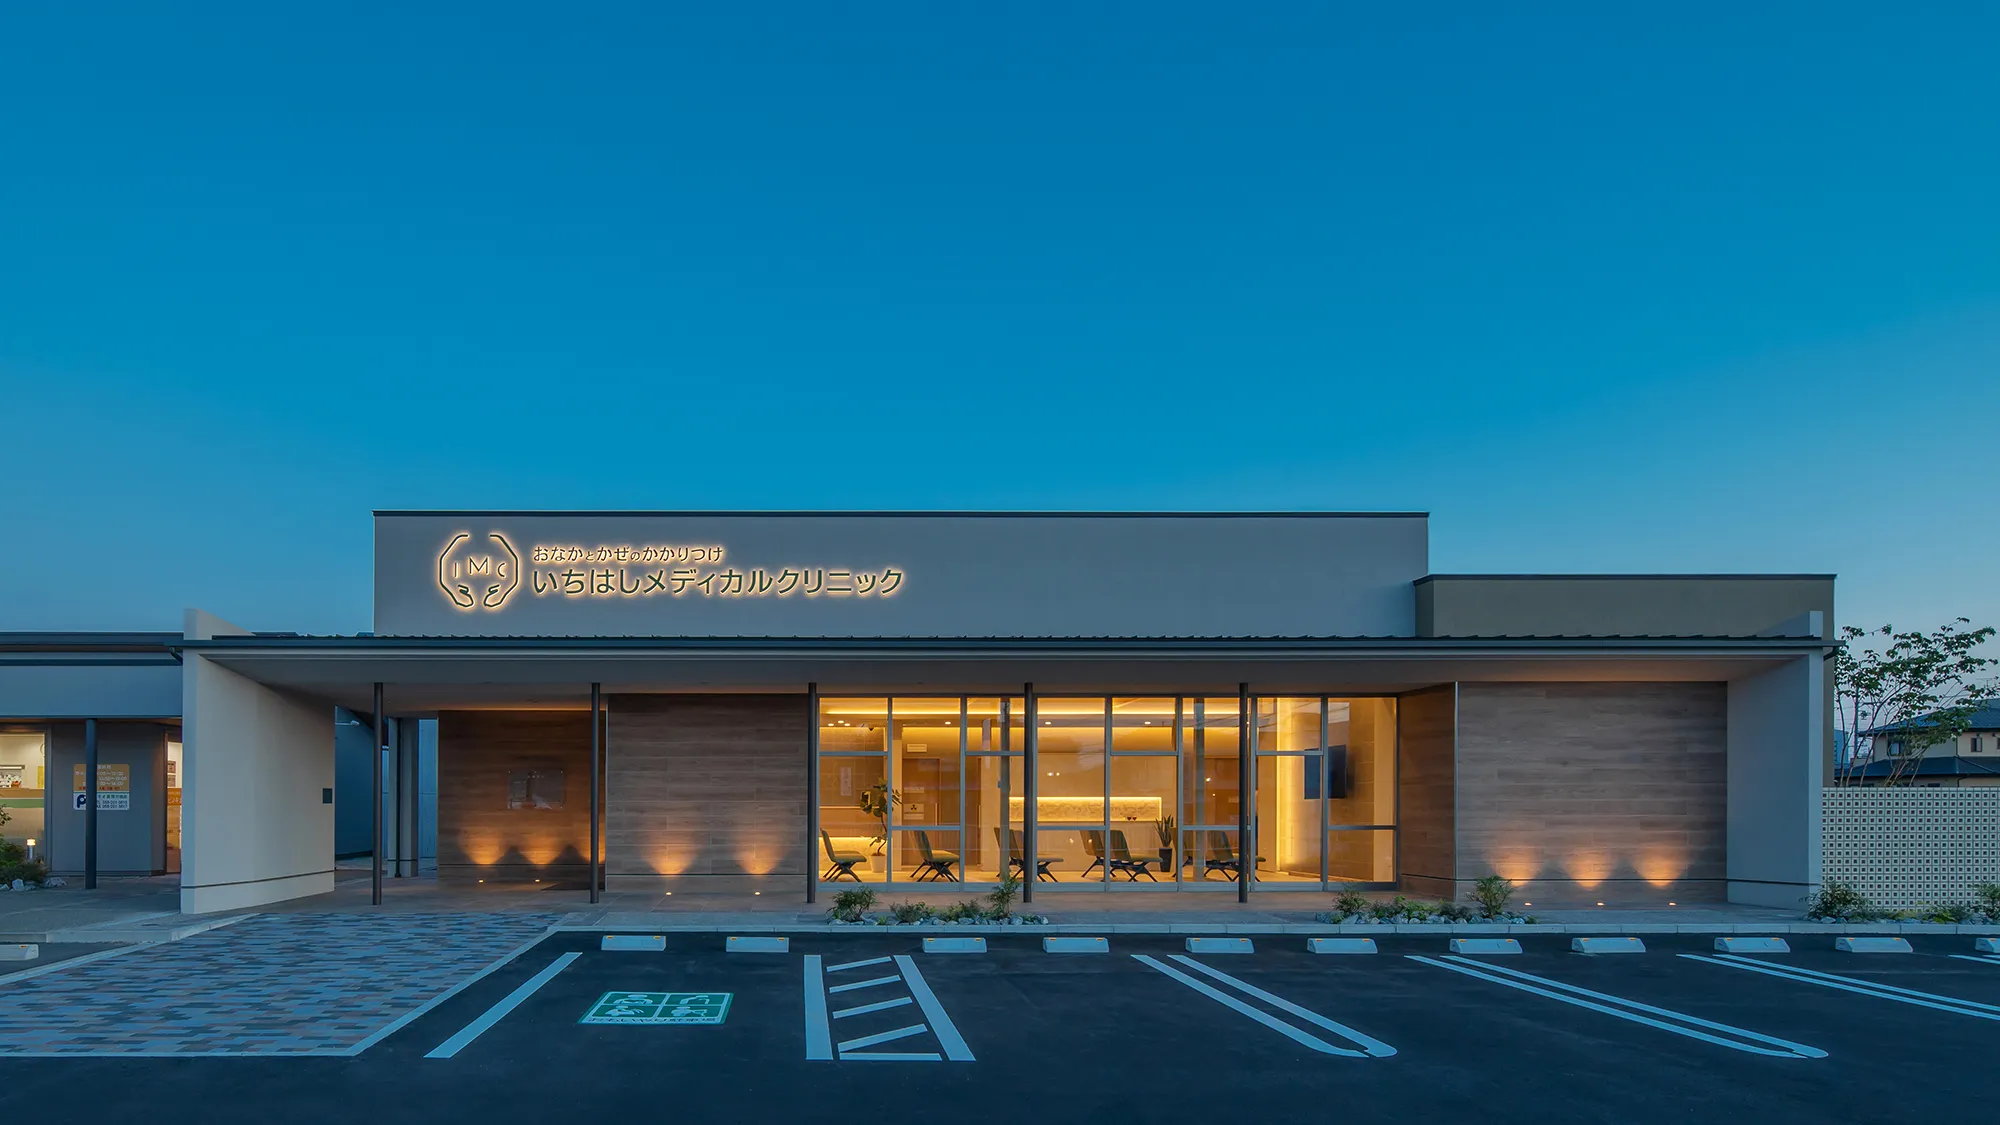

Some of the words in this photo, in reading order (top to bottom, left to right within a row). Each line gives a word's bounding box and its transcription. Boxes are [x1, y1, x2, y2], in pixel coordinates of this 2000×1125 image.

[533, 546, 722, 562] おなかとかぜのかかりつけ
[533, 568, 902, 594] いちはしメディカルクリニック
